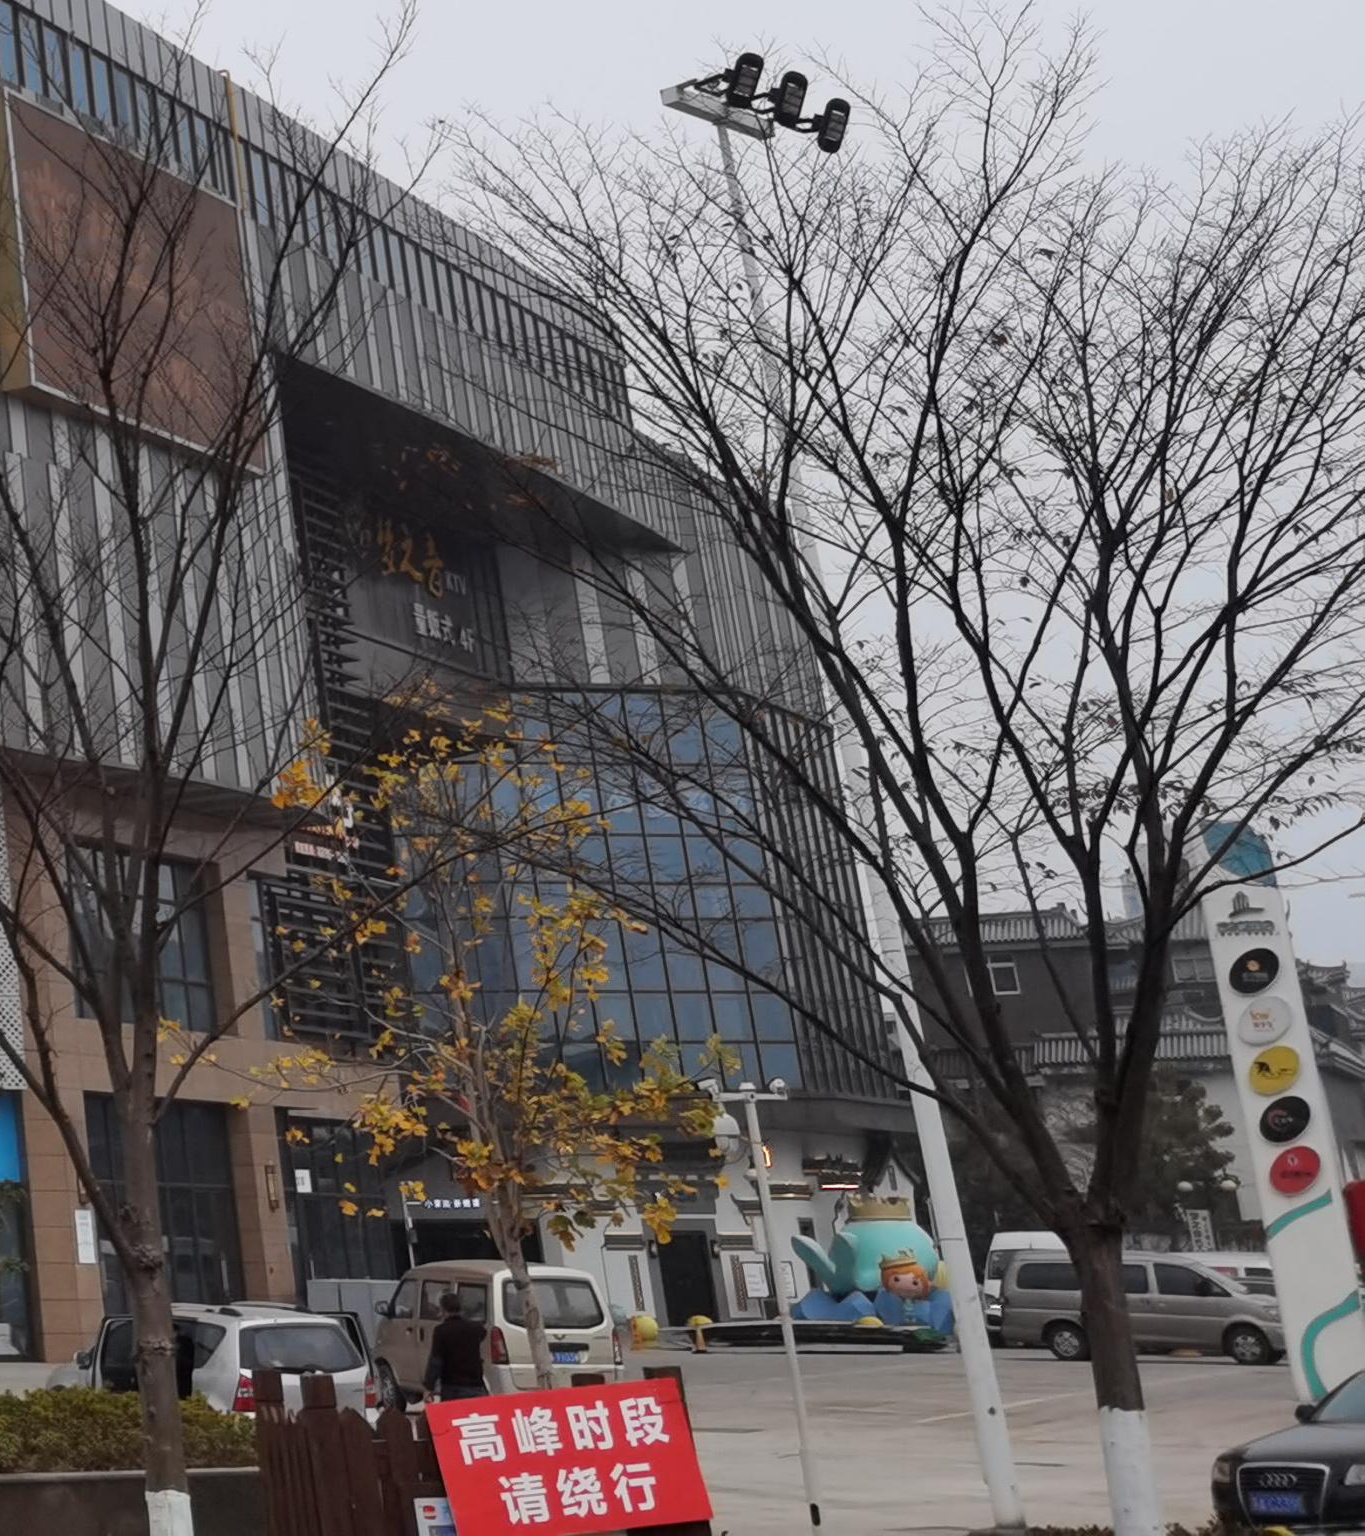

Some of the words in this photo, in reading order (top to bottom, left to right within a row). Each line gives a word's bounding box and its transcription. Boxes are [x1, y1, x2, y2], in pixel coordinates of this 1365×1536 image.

[451, 1396, 672, 1465] 高峰时段
[498, 1462, 658, 1525] 请绕行
